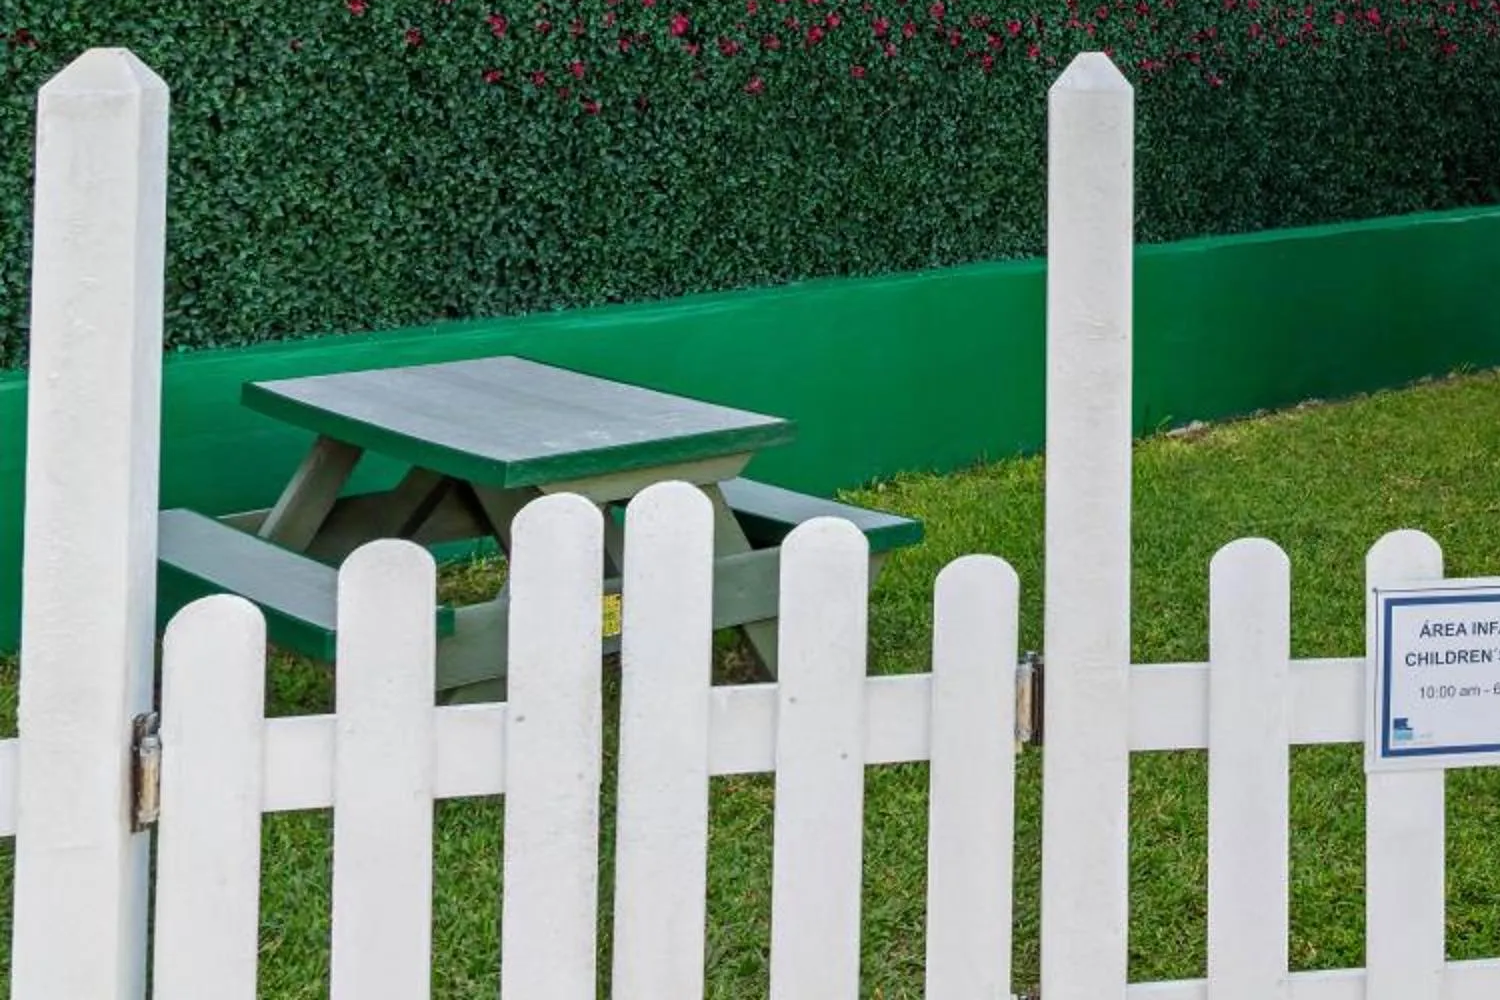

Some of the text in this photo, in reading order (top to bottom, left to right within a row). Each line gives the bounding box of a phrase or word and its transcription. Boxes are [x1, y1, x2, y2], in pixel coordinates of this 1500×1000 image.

[1420, 620, 1467, 638] ÁREA
[1420, 685, 1456, 699] 10:00
[1459, 686, 1481, 697] am
